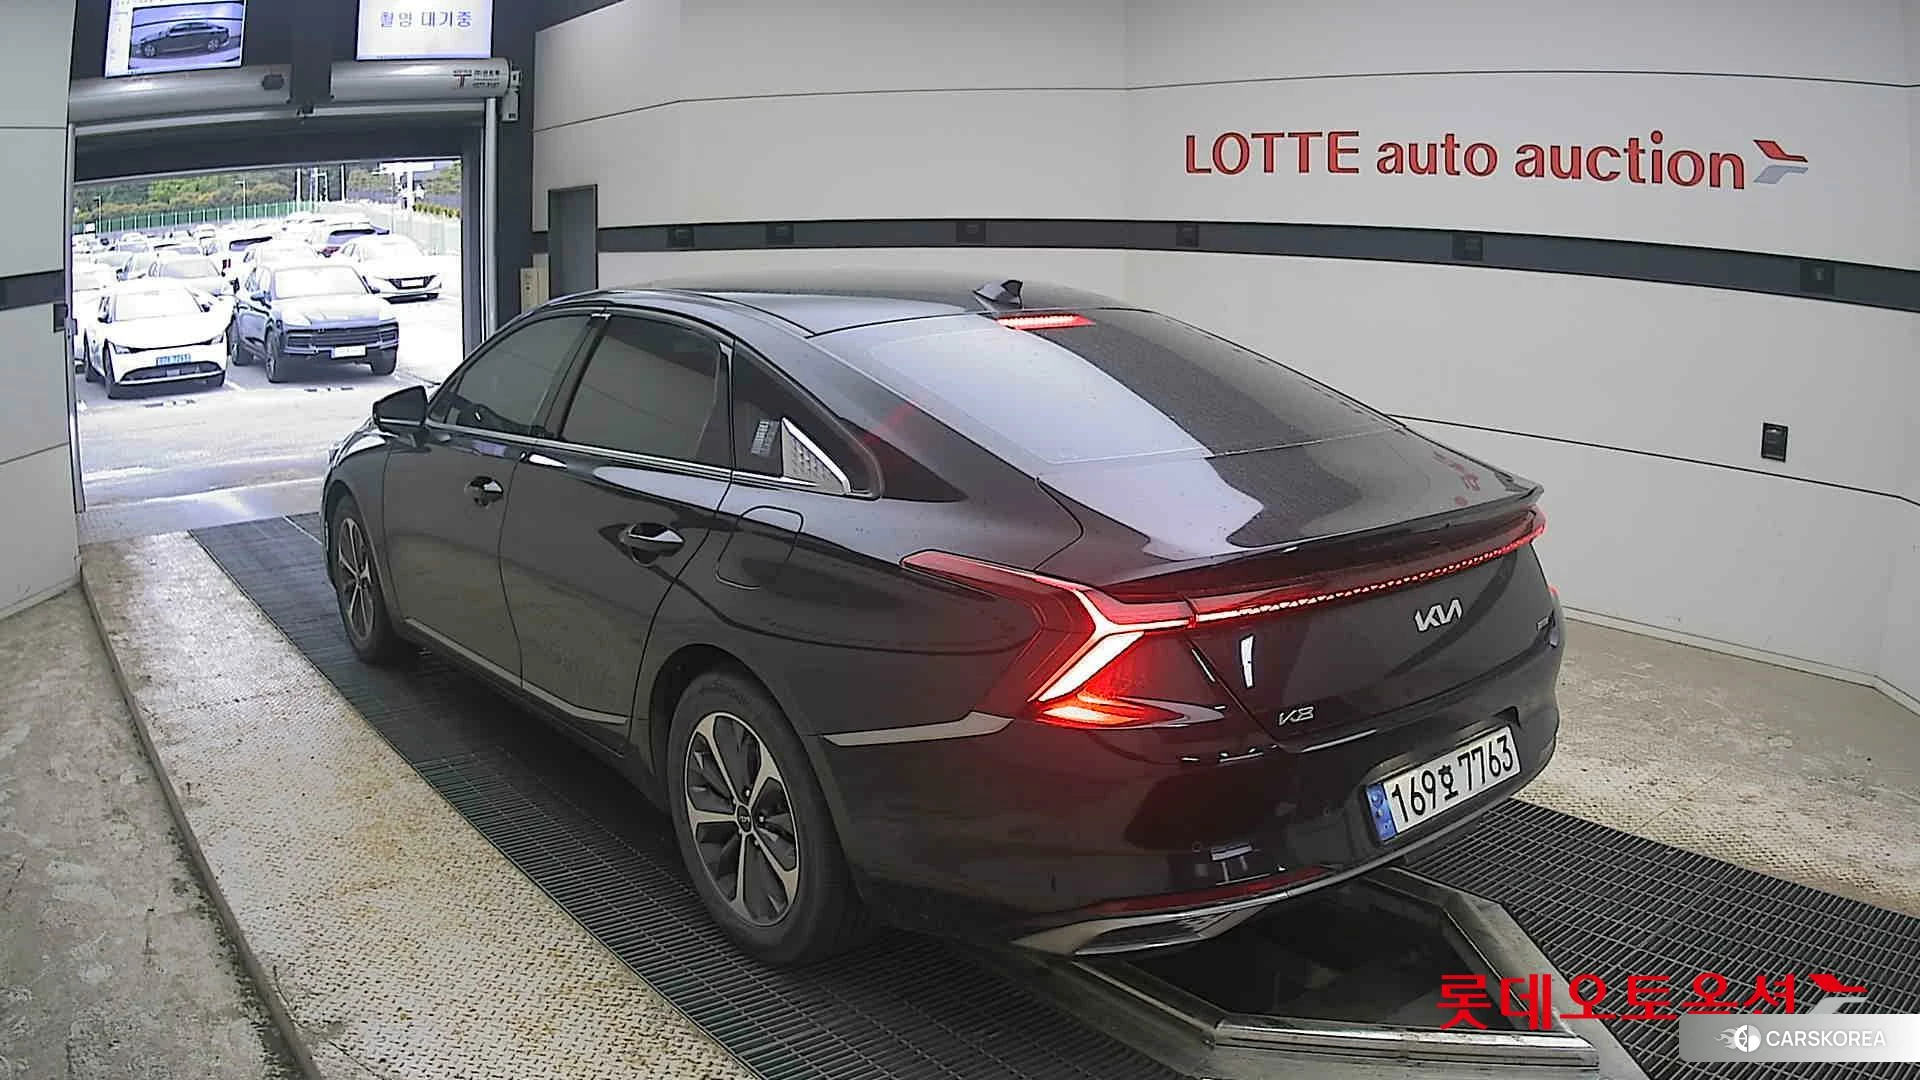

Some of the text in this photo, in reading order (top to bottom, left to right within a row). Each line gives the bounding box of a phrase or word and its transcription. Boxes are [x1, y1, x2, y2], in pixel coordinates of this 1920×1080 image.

[421, 11, 472, 28] 대기중
[1185, 131, 1745, 189] LOTTE auto auction
[1279, 706, 1314, 726] K8
[1457, 735, 1514, 791] 7763
